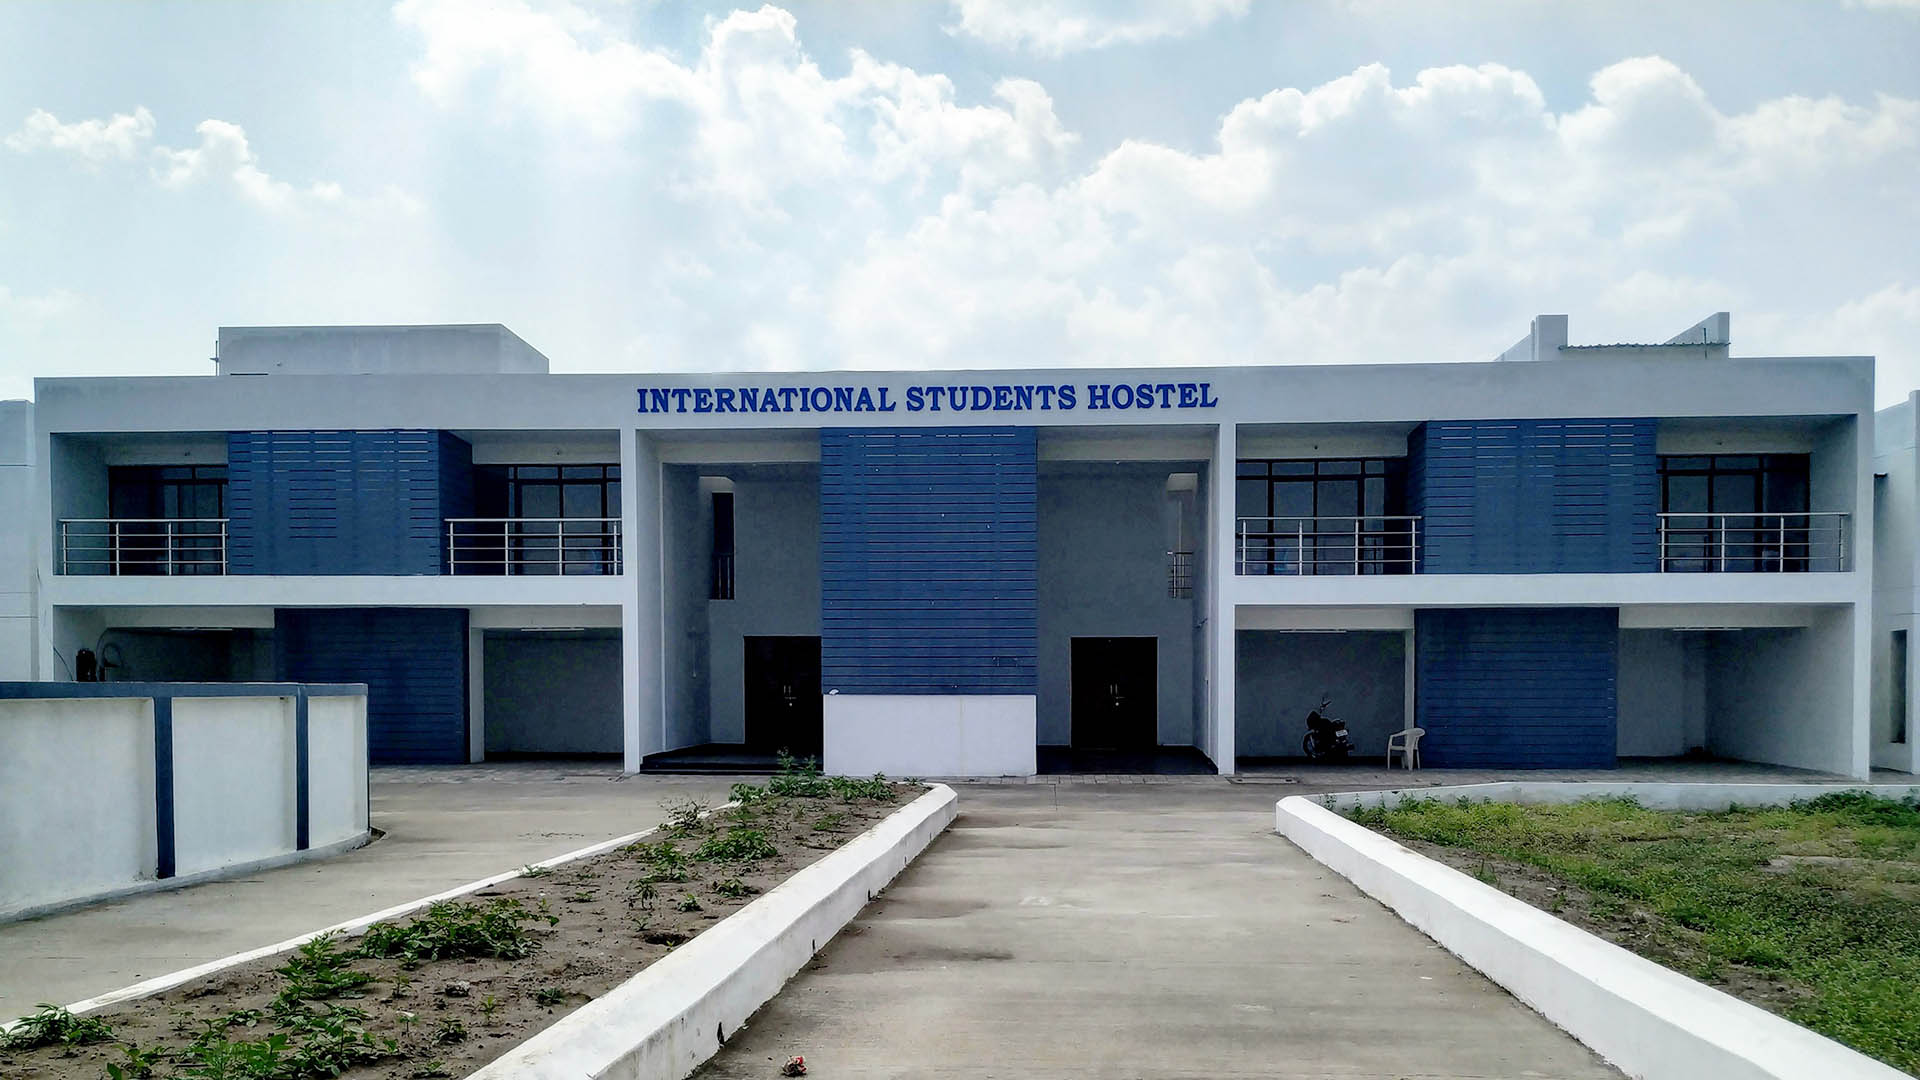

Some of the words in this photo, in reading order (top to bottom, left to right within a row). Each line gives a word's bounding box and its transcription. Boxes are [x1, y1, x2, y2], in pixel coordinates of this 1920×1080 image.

[637, 387, 896, 413] INTERNATIONAL
[906, 385, 1077, 412] STUDENTS
[1088, 383, 1218, 410] HOSTEL
